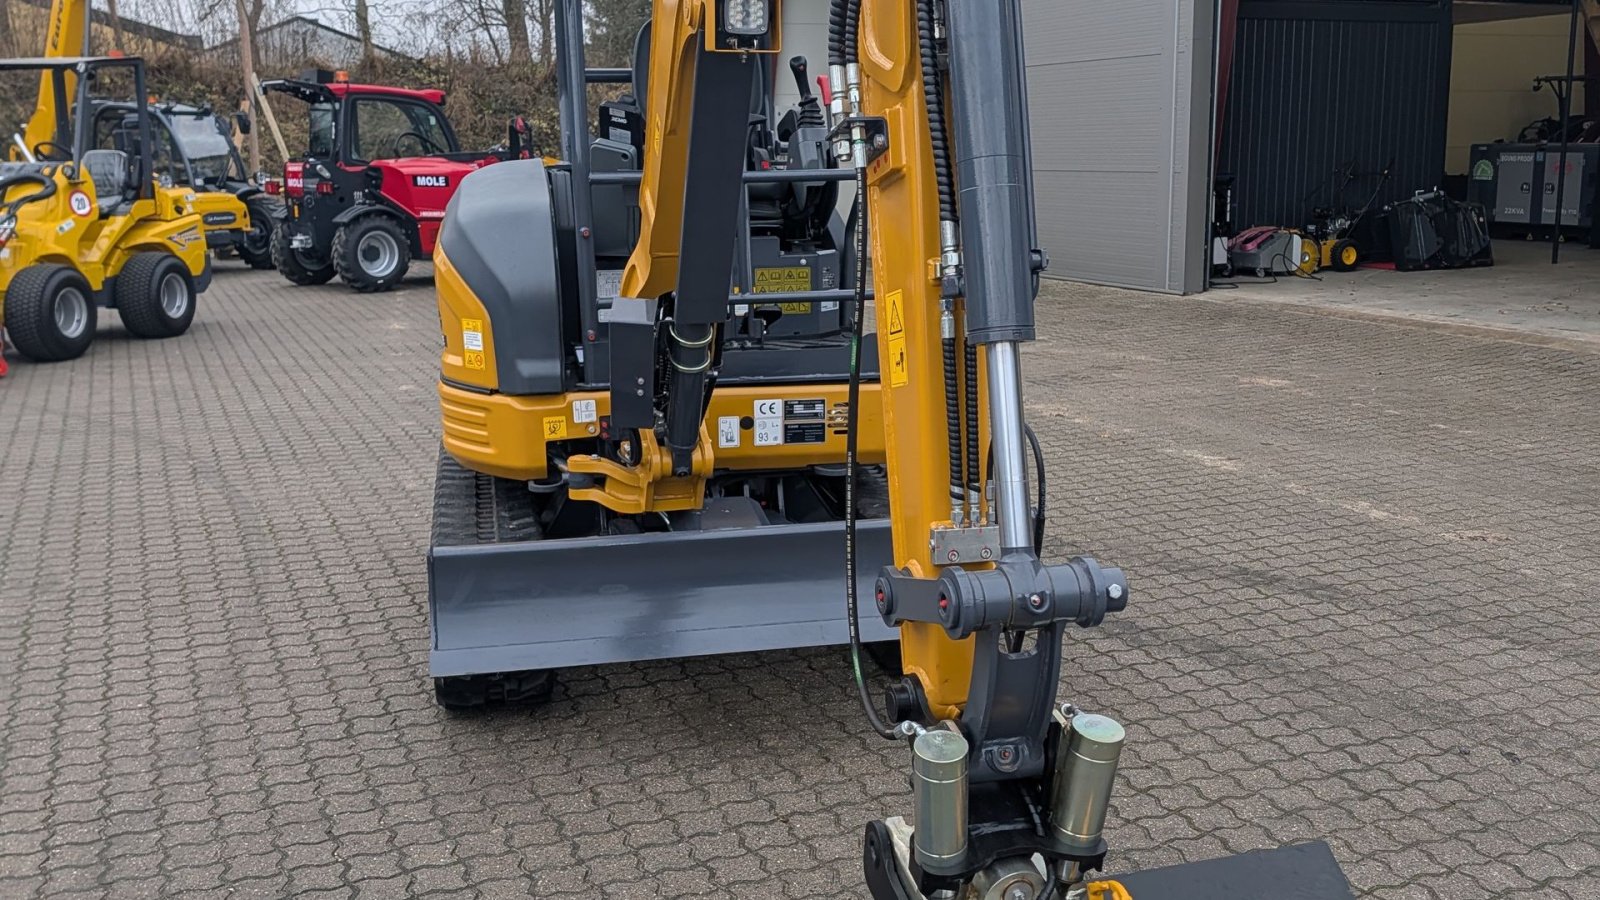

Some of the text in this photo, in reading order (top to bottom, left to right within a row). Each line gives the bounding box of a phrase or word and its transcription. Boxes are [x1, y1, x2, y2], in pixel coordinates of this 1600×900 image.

[416, 176, 446, 187] MOLE
[75, 197, 86, 210] 20
[1504, 207, 1525, 216] 22KVA
[759, 402, 776, 415] CE
[758, 432, 769, 442] 93
